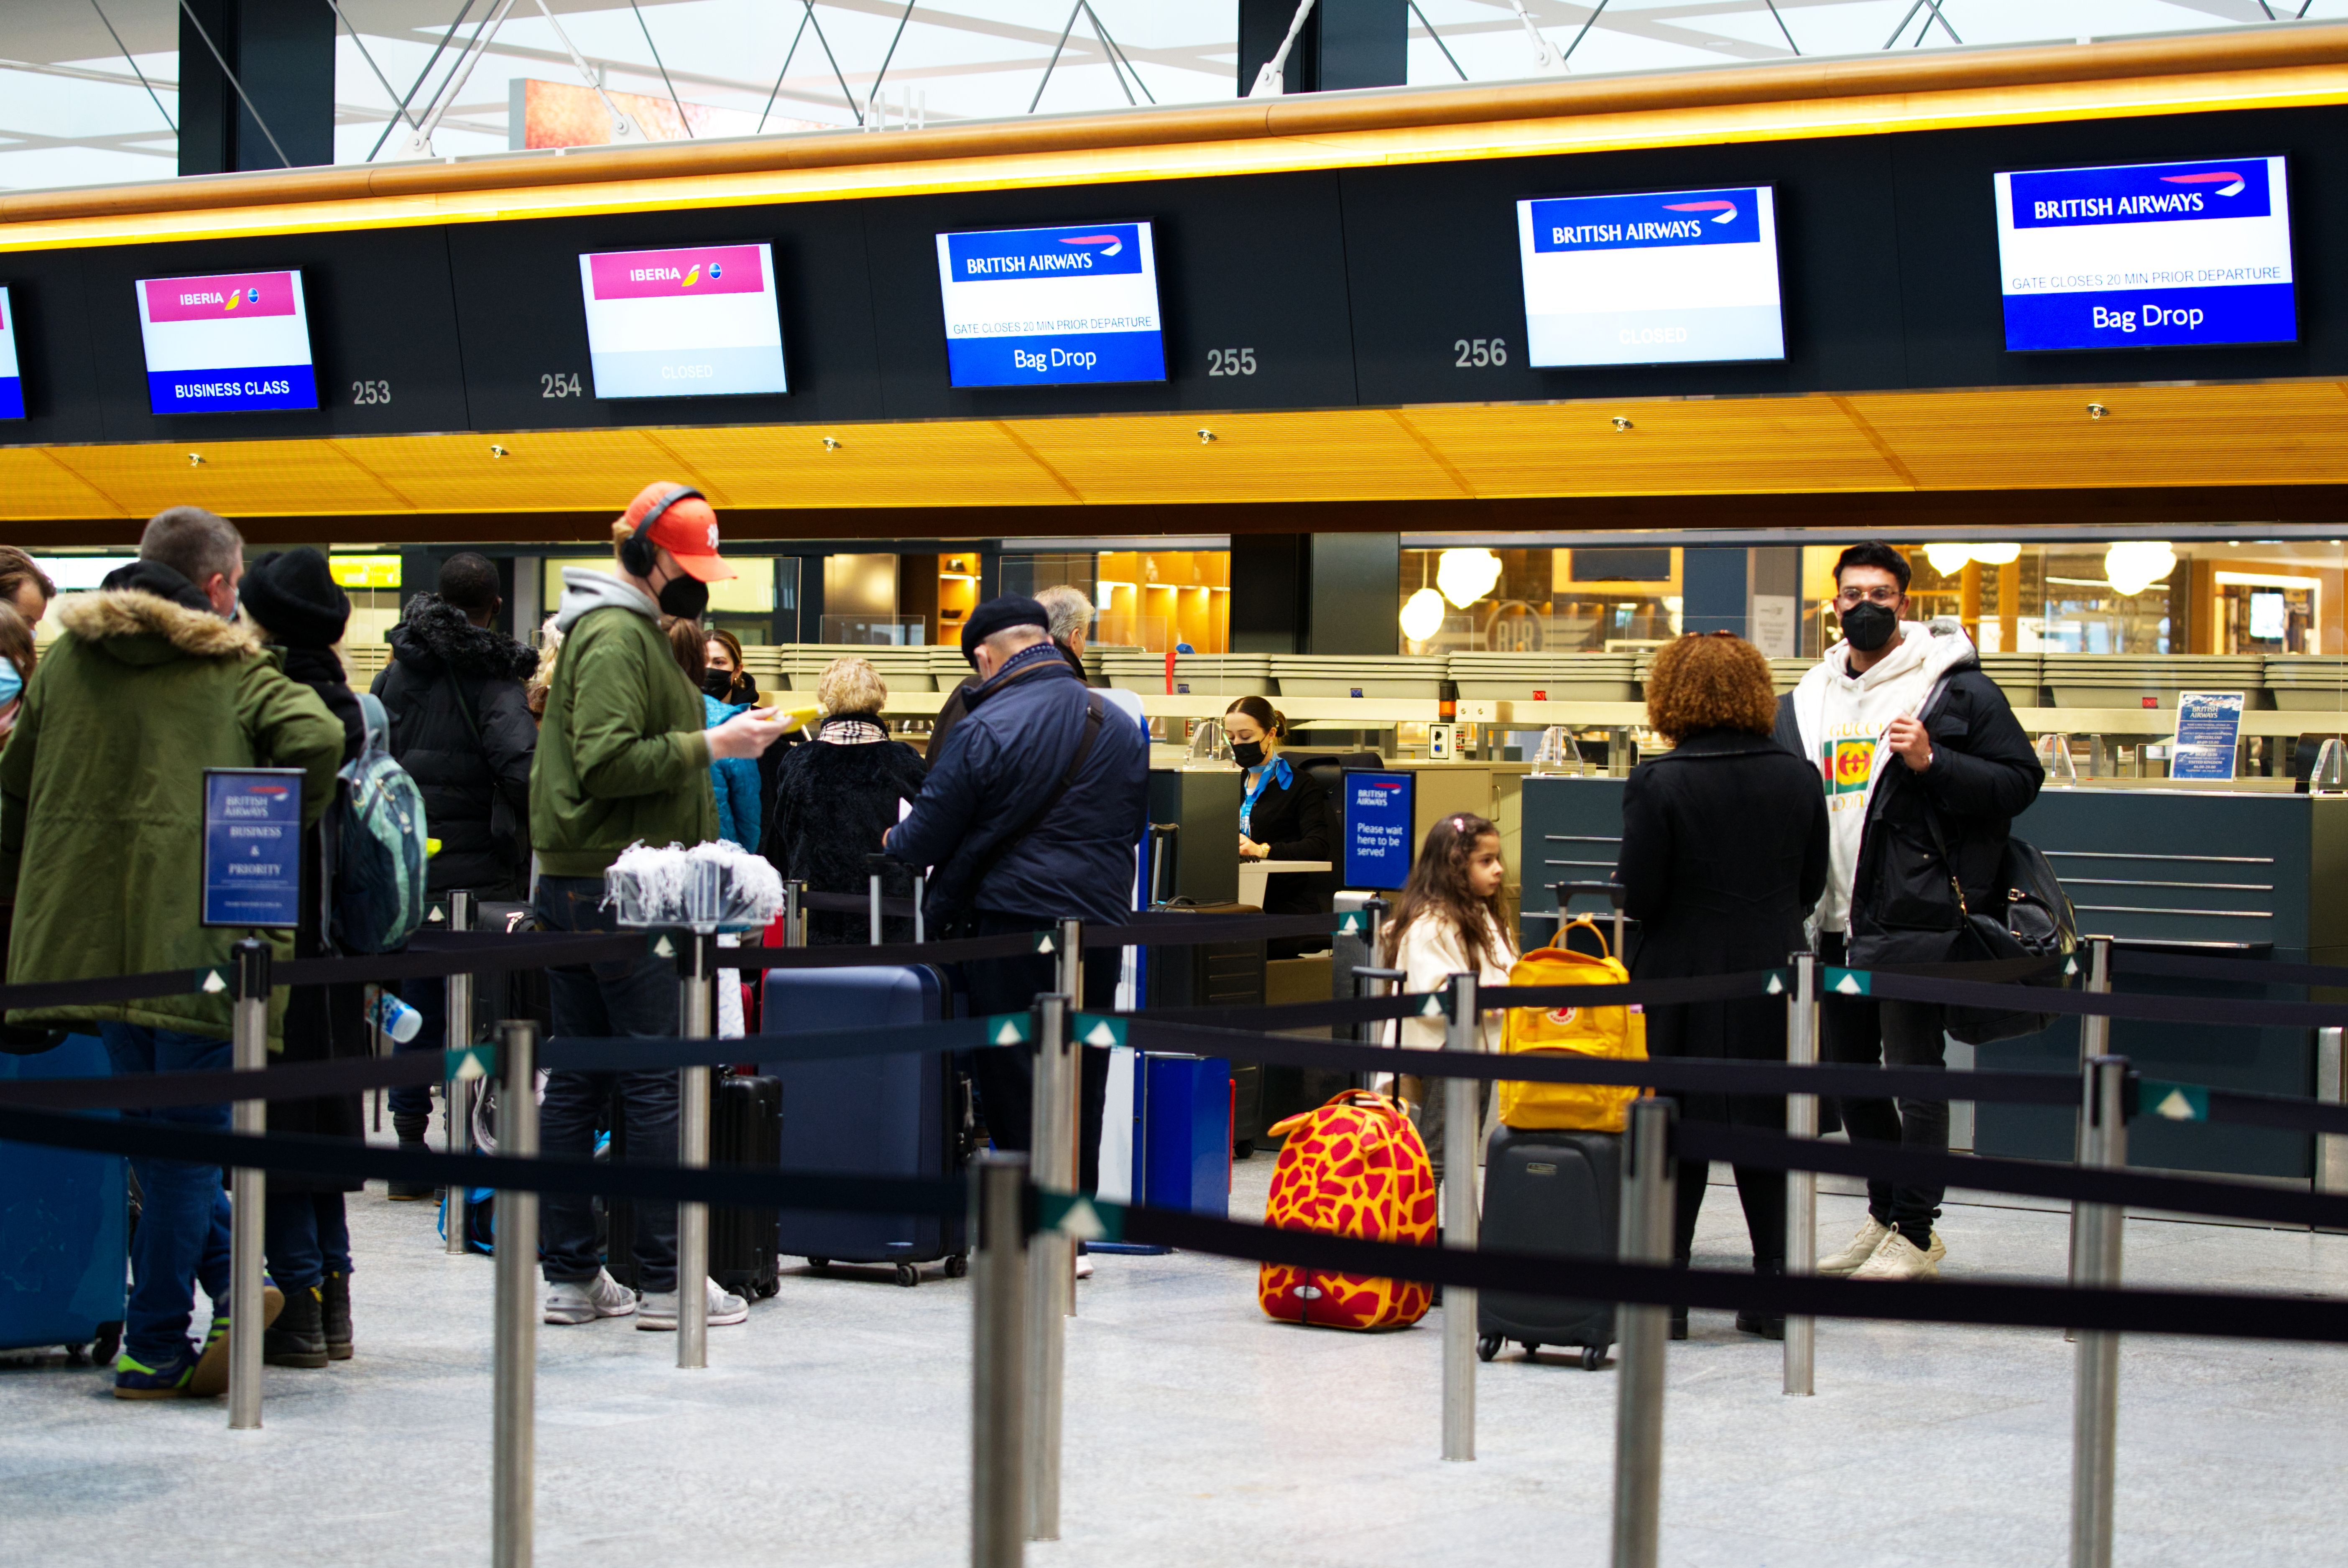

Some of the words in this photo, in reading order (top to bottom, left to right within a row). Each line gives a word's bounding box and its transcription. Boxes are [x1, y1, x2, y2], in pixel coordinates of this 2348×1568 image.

[2034, 197, 2113, 219] BRITISH
[2118, 193, 2204, 214] AIRWAYS
[1552, 224, 1622, 244] BRITISH
[1626, 220, 1702, 241] AIRWAYS
[967, 257, 1026, 274] BRITISH
[1029, 252, 1092, 270] AIRWAYS
[630, 267, 681, 281] IBERIA
[2012, 277, 2047, 290] GATE
[2051, 275, 2103, 288] CLOSES
[2107, 273, 2121, 286] 20
[2125, 272, 2148, 284] MIN
[2152, 270, 2194, 283] PRIOR
[2198, 267, 2281, 282] DEPARTURE
[180, 292, 224, 306] IBERIA
[953, 323, 979, 334] GATE
[982, 322, 1021, 334] CLOSES
[1023, 321, 1034, 332] 20
[1036, 320, 1054, 331] MIN
[1057, 319, 1088, 330] PRIOR
[1090, 316, 1152, 329] DEPARTURE
[2093, 306, 2136, 332] Bag
[2143, 304, 2204, 329] Drop
[1619, 327, 1687, 344] CLOSED
[1014, 349, 1047, 372] Bag
[1051, 348, 1097, 370] Drop
[1455, 338, 1507, 367] 256
[1207, 348, 1257, 376] 255
[661, 365, 713, 380] CLOSED
[175, 382, 241, 398] BUSINESS
[245, 380, 290, 395] CLASS
[352, 380, 391, 405] 253
[541, 373, 582, 398] 254
[1830, 722, 1883, 737] GUCCI
[225, 795, 268, 807] BRITISH
[1358, 789, 1387, 798] BRITISH
[1356, 798, 1388, 807] AIRWAYS
[224, 807, 268, 818] AIRWAYS
[230, 826, 282, 837] BUSINESS
[1357, 822, 1383, 834] Please
[1385, 824, 1403, 835] wait
[1357, 834, 1376, 845] here
[1378, 837, 1387, 845] to
[1388, 836, 1400, 846] be
[251, 845, 260, 857] &
[1357, 847, 1385, 857] served
[228, 864, 281, 875] PRIORITY
